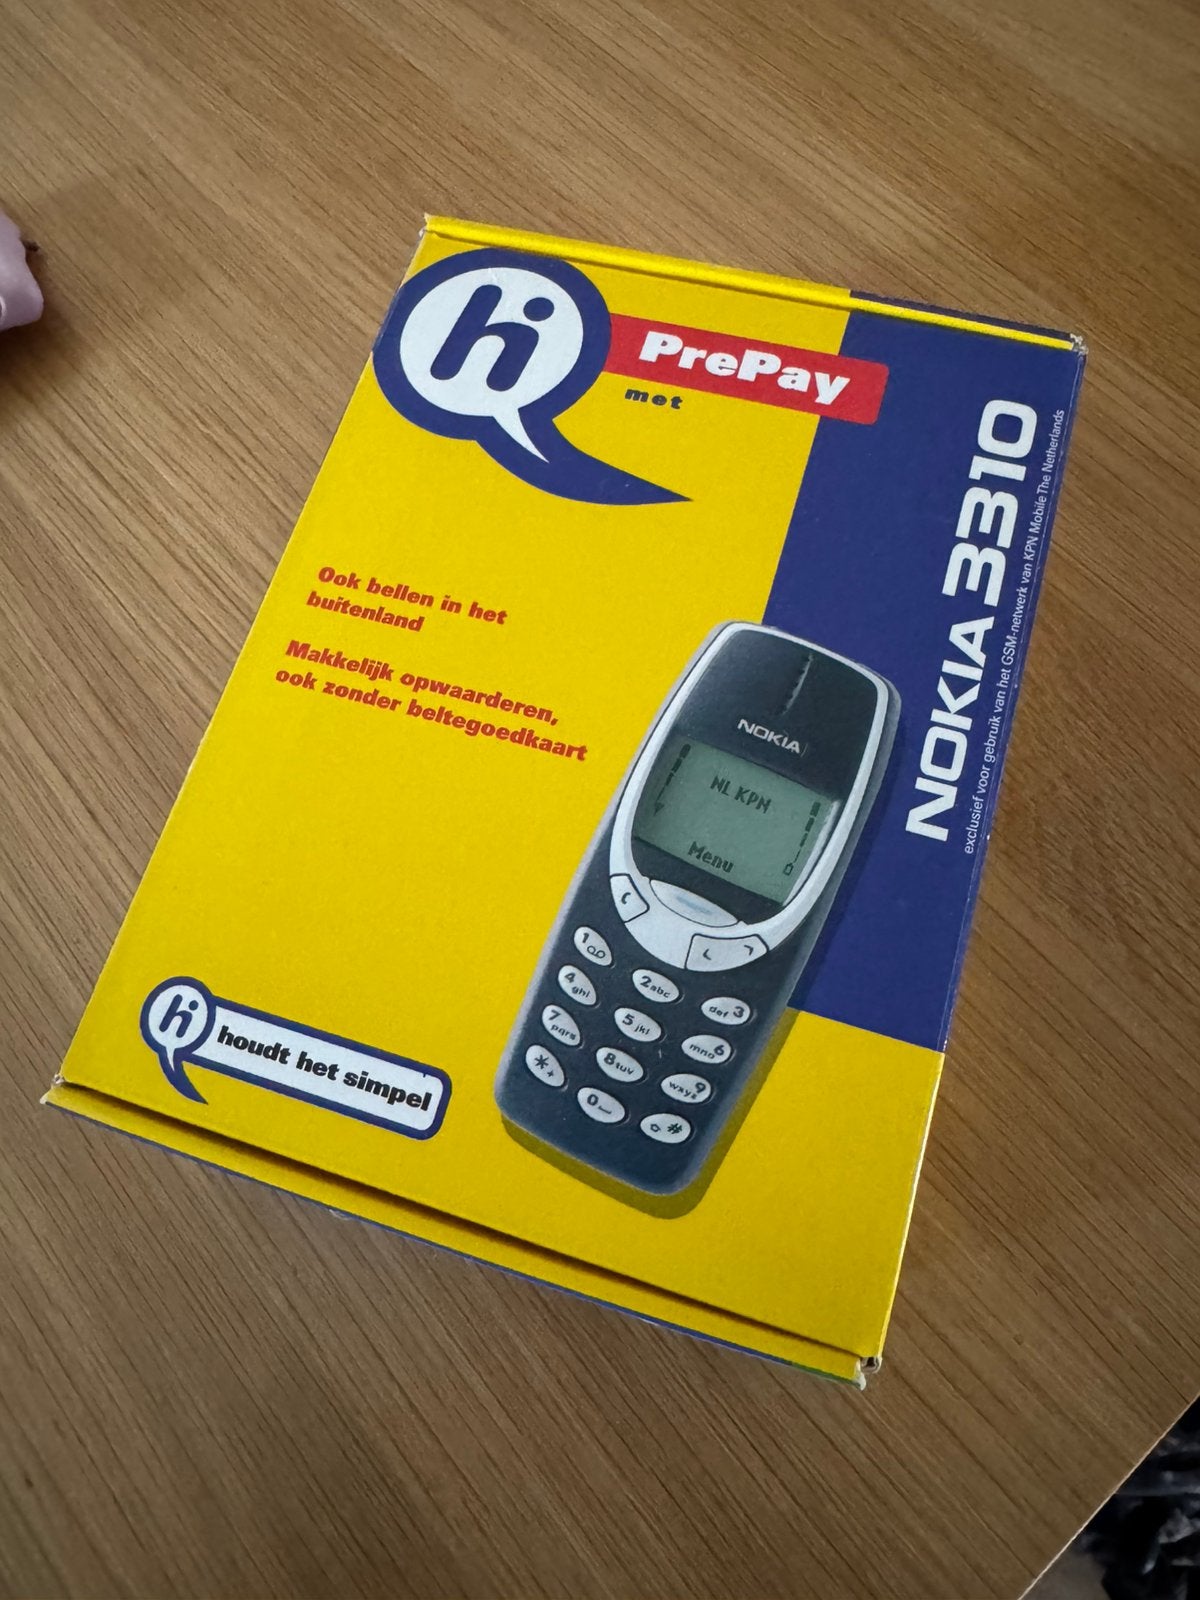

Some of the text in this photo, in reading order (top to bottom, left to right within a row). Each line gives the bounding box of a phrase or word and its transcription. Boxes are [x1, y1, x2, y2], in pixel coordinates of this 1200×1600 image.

[430, 284, 554, 392] hi
[639, 331, 850, 405] PrePay
[624, 388, 683, 410] met
[306, 591, 425, 632] buitenland
[318, 566, 508, 625] Ook bellen in het
[965, 409, 1065, 854] exclusief voor gebruik van het GSM-netwerk van KPN Mobile The Netherlands
[285, 640, 559, 726] Makkelijk opwaarderen,
[275, 669, 588, 761] ook zonder beltegoedkaart
[737, 718, 801, 754] NOKIA
[710, 776, 772, 814] NL KPN
[688, 841, 734, 874] Menu
[582, 932, 590, 943] 1
[564, 972, 590, 998] 4 ghi
[159, 993, 199, 1038] hi
[550, 1010, 577, 1041] 7 pqrs
[622, 1014, 651, 1035] 5 jkl
[709, 1005, 745, 1018] def 3
[217, 1025, 433, 1111] houdt het simpel
[690, 1044, 725, 1060] mno 6
[587, 1094, 597, 1106] 0
[668, 1081, 706, 1100] wxyz 9
